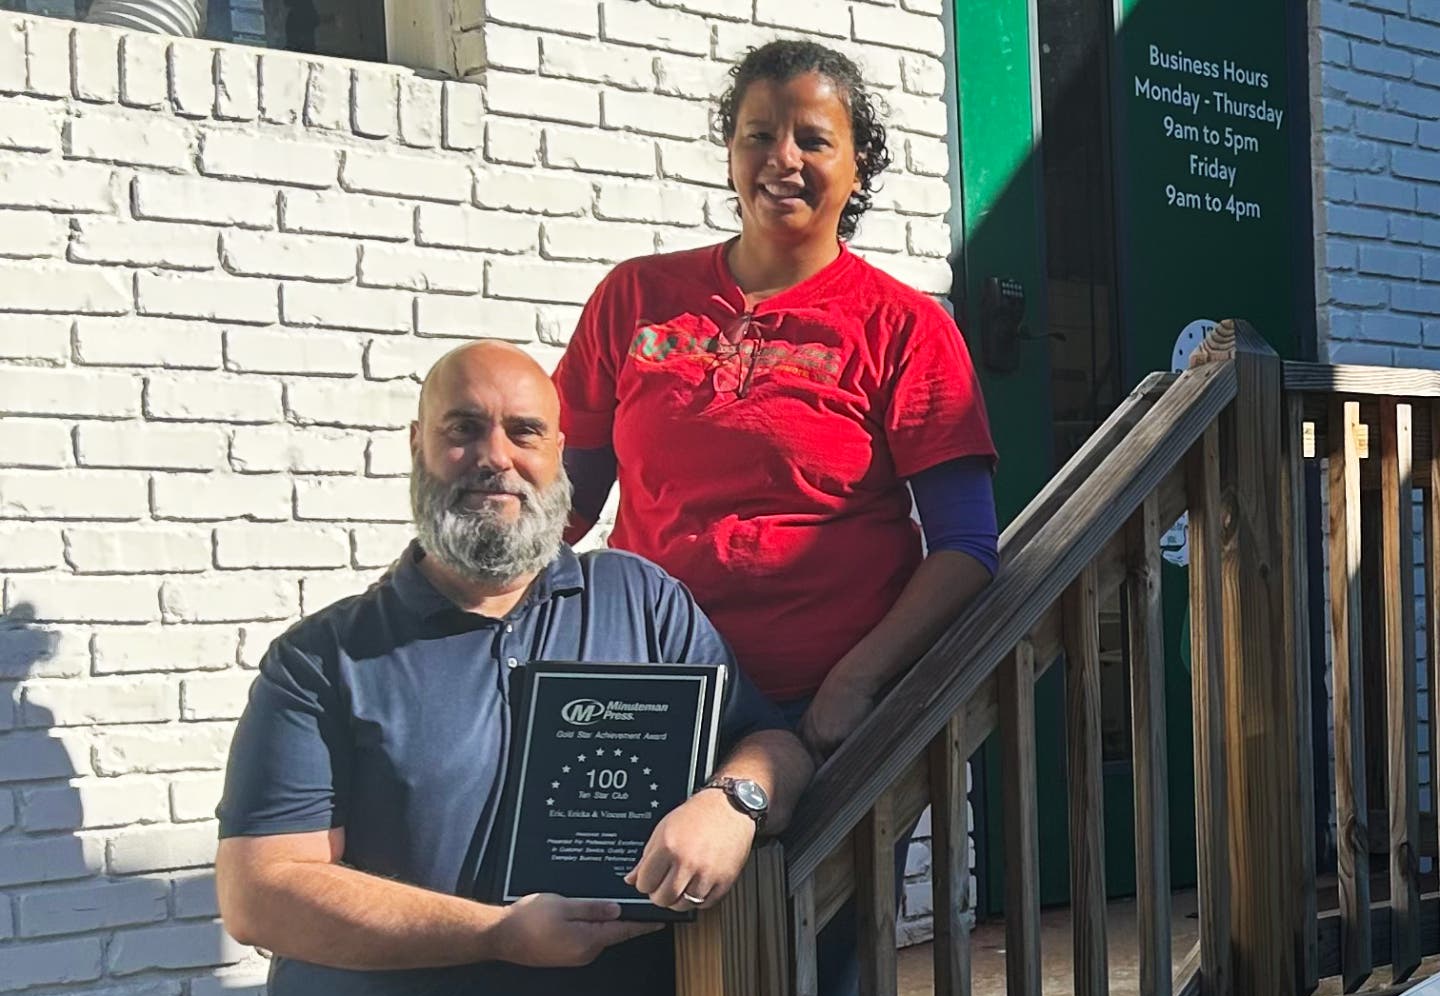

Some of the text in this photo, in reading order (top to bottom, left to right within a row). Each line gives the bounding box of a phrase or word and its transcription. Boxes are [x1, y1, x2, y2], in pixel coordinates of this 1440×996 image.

[1150, 44, 1269, 88] Business Hours
[1134, 75, 1201, 115] Monday
[1213, 91, 1283, 130] Thursday
[1163, 115, 1259, 155] 9am to 5pm
[1190, 154, 1237, 188] Friday
[1165, 184, 1261, 222] 9am to 4pm
[606, 701, 669, 712] Minuteman
[556, 730, 667, 741] Gold Star Achievement Award
[586, 769, 628, 789] 100
[593, 791, 609, 800] Star
[611, 792, 629, 800] Club
